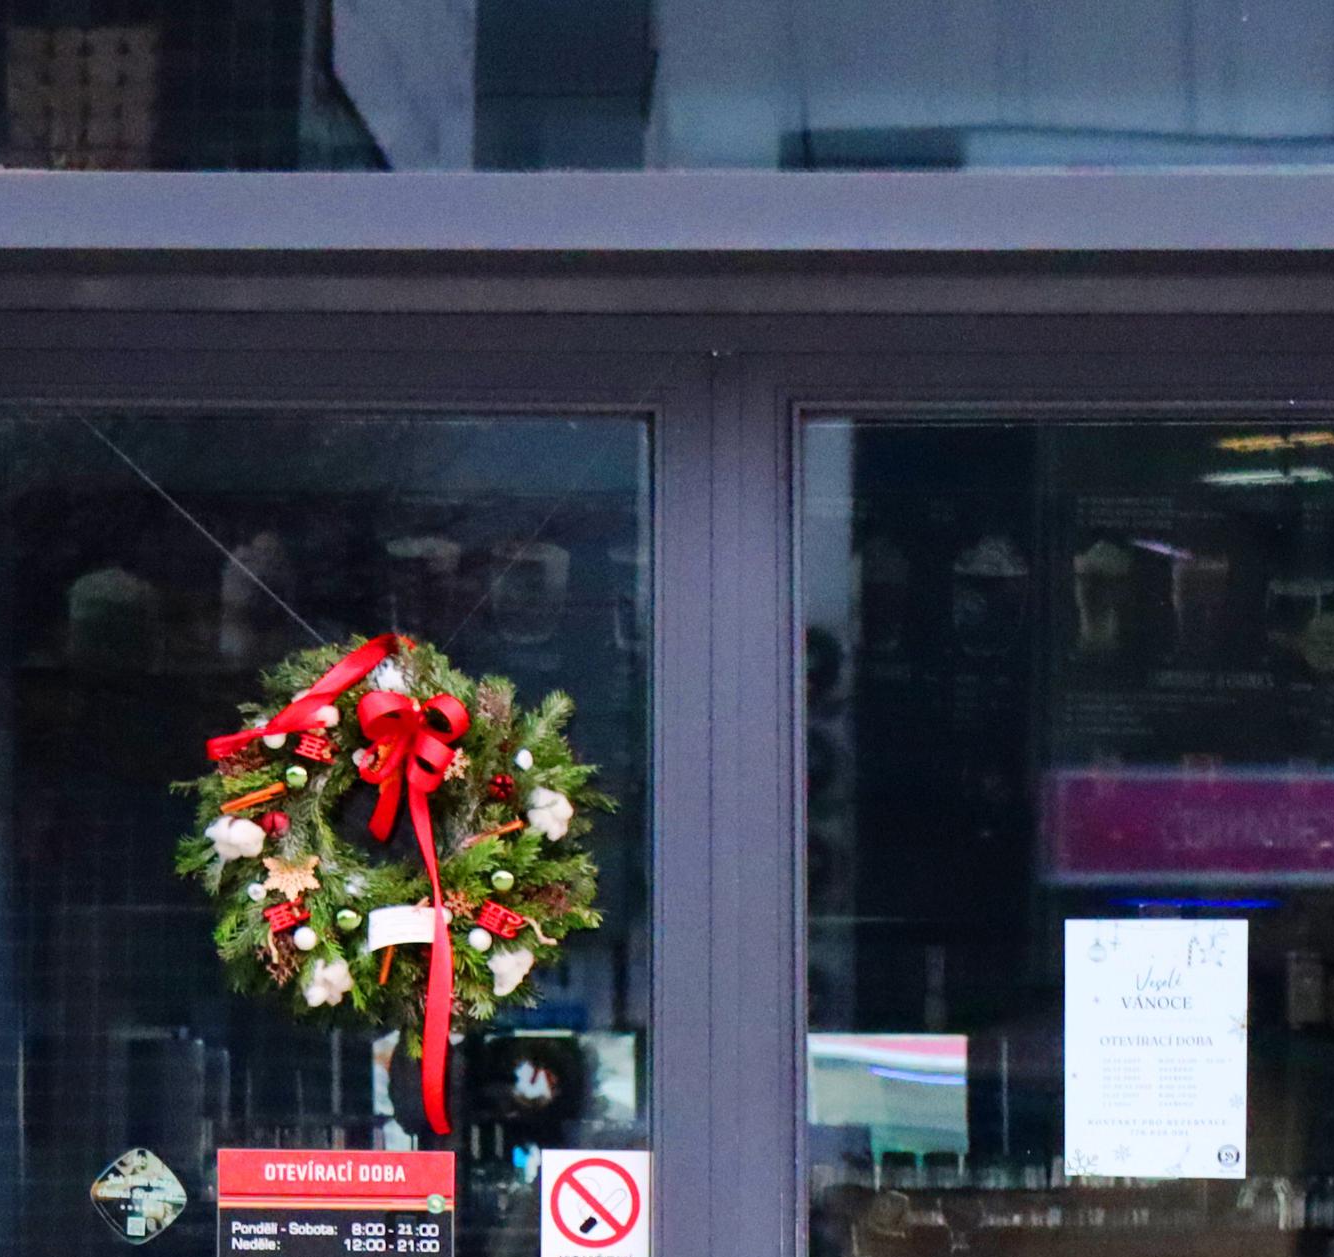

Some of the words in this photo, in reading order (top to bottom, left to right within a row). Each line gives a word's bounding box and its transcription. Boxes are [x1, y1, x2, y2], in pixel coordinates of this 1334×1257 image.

[1121, 994, 1193, 1011] VÁNOCE
[1099, 1033, 1173, 1048] OTEVÍRACÍ
[1175, 1035, 1214, 1048] DOBA
[264, 1159, 353, 1182] OTEVÍRACÍ
[358, 1164, 406, 1182] DOBA
[231, 1221, 278, 1235] Pondělí
[288, 1221, 338, 1236] Sobota:
[351, 1222, 386, 1236] 8:00
[231, 1236, 281, 1251] Neděle:
[343, 1238, 387, 1252] 12:00
[397, 1238, 440, 1253] 21:00
